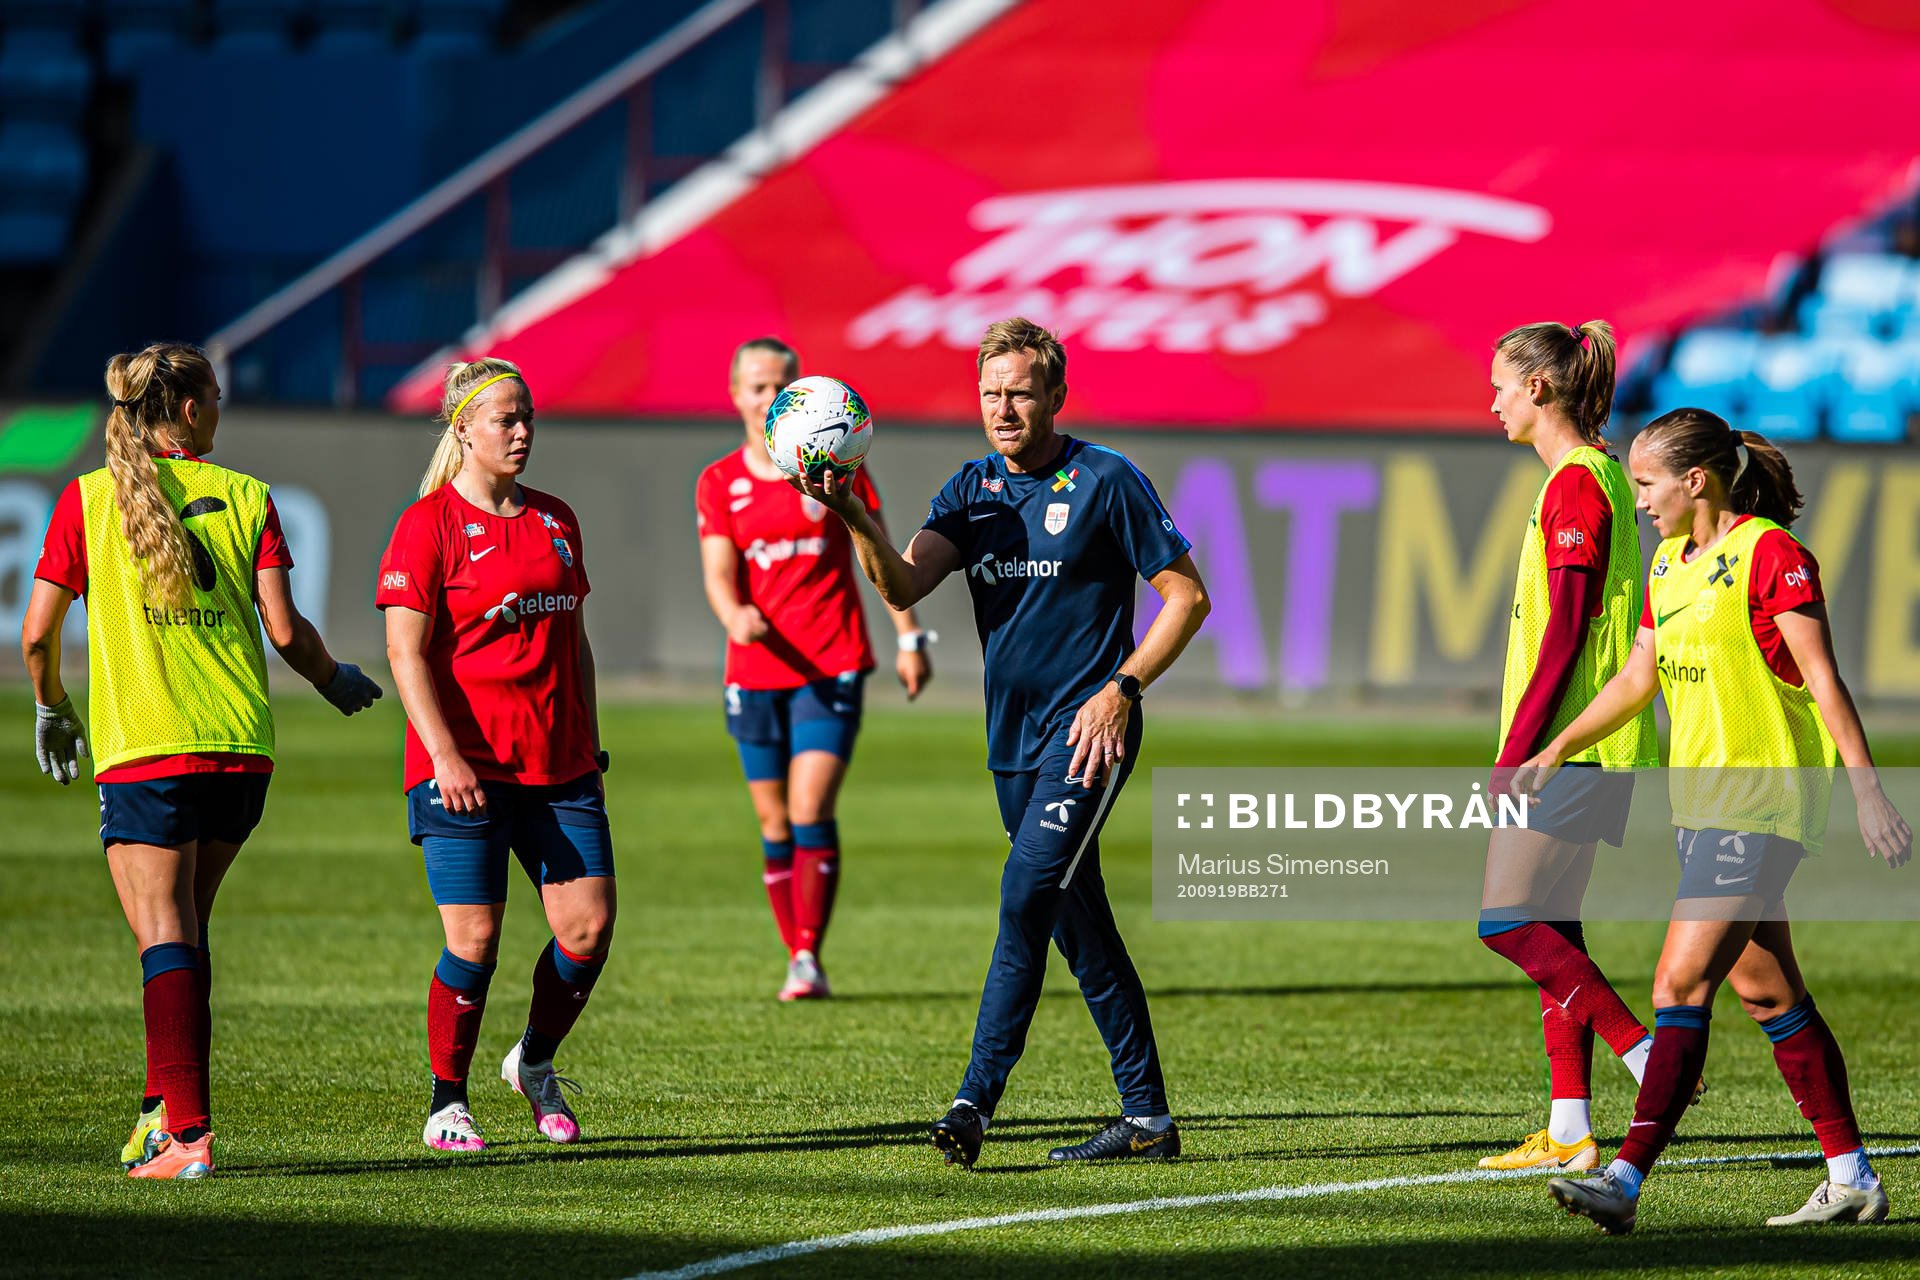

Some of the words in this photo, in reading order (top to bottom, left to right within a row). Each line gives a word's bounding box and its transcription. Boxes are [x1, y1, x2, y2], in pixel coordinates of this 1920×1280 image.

[948, 178, 1552, 298] THON
[1557, 527, 1584, 548] DNB
[995, 556, 1063, 578] telenor
[383, 570, 406, 590] DNB
[1040, 819, 1068, 833] telenor
[1715, 853, 1746, 865] telenor
